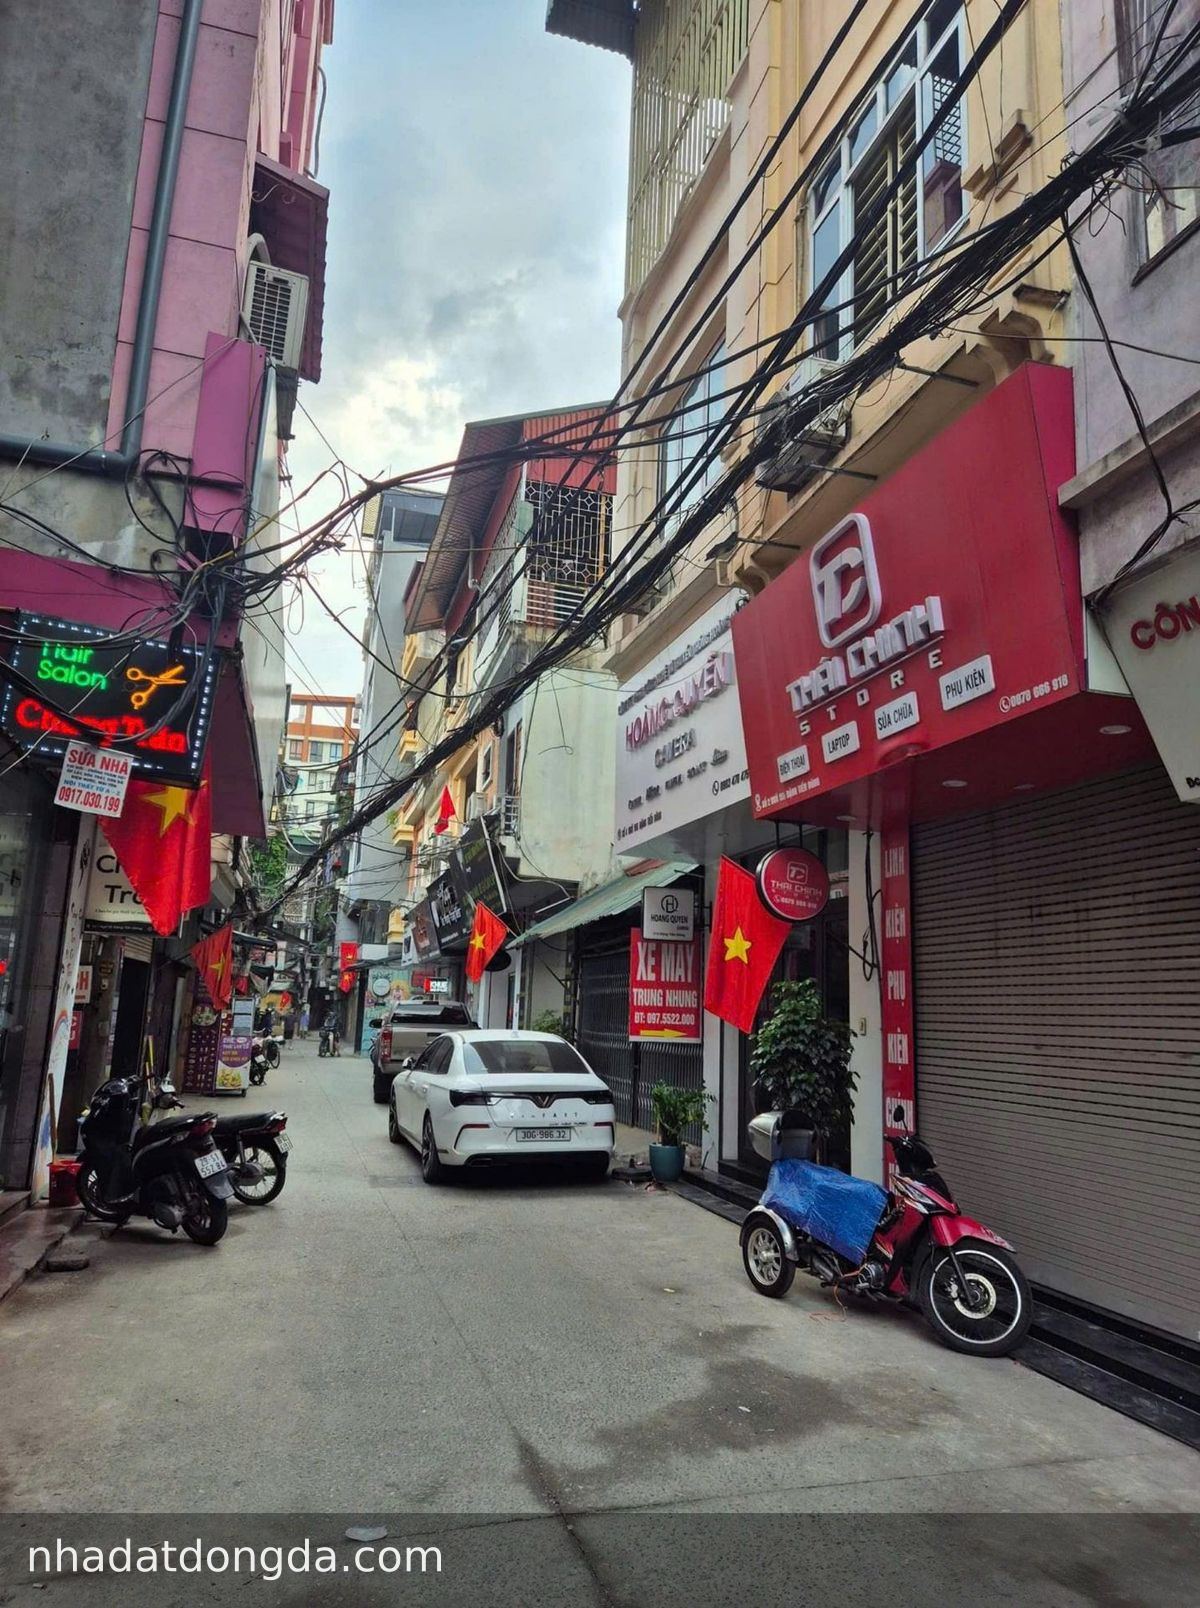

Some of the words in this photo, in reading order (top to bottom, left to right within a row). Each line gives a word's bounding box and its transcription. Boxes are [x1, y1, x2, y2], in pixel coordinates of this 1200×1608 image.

[37, 660, 108, 690] Salon
[965, 668, 986, 691] KIỆN
[827, 733, 850, 754] LAPTOP
[636, 942, 656, 981] XE
[632, 988, 663, 1006] TRUNG
[665, 989, 698, 1008] NHUNG
